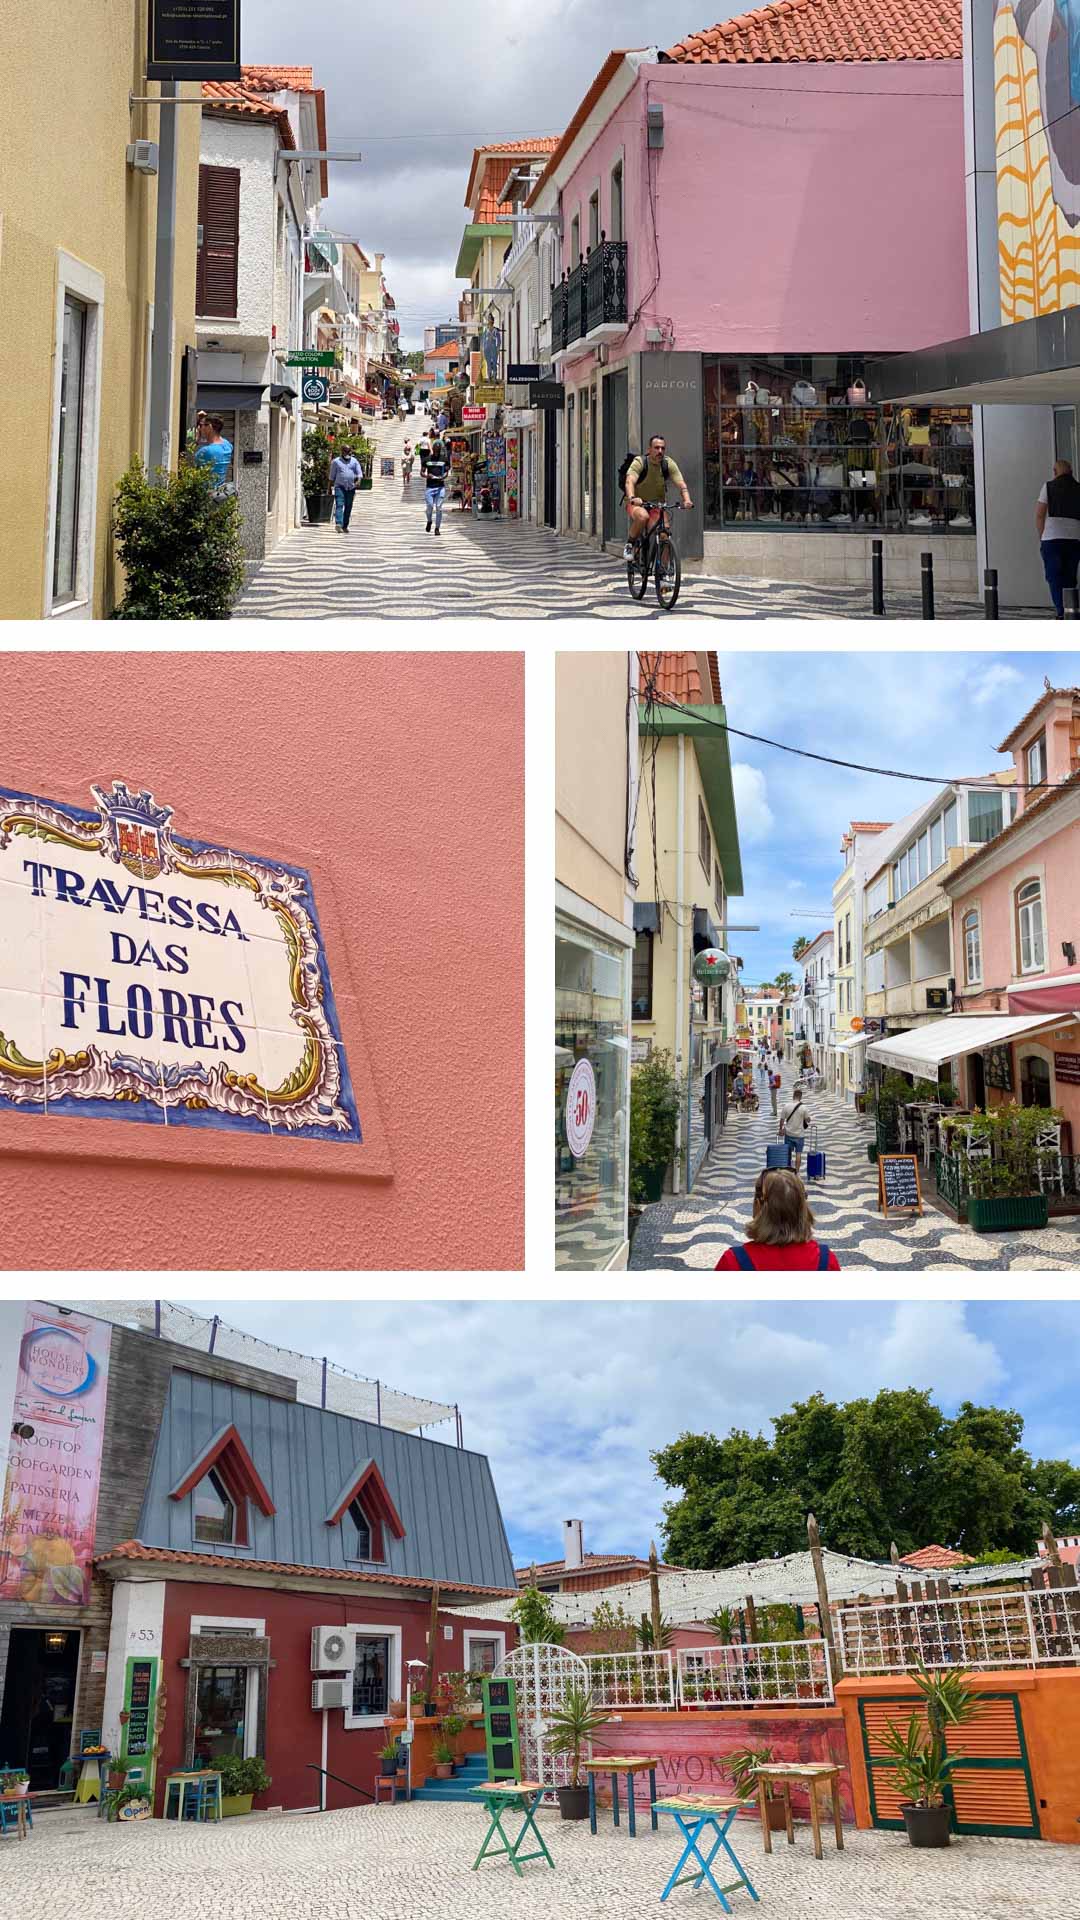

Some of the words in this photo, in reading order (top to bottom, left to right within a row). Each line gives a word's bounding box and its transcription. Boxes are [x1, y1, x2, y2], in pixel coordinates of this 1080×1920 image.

[23, 860, 250, 942] TRAVESSA
[110, 931, 190, 975] DAS
[59, 971, 247, 1054] FLORES
[33, 1345, 72, 1362] HOUSE
[8, 1455, 93, 1480] OOFGARDEN
[10, 1481, 80, 1503] PATISSERIA
[23, 1508, 65, 1525] MEZZE
